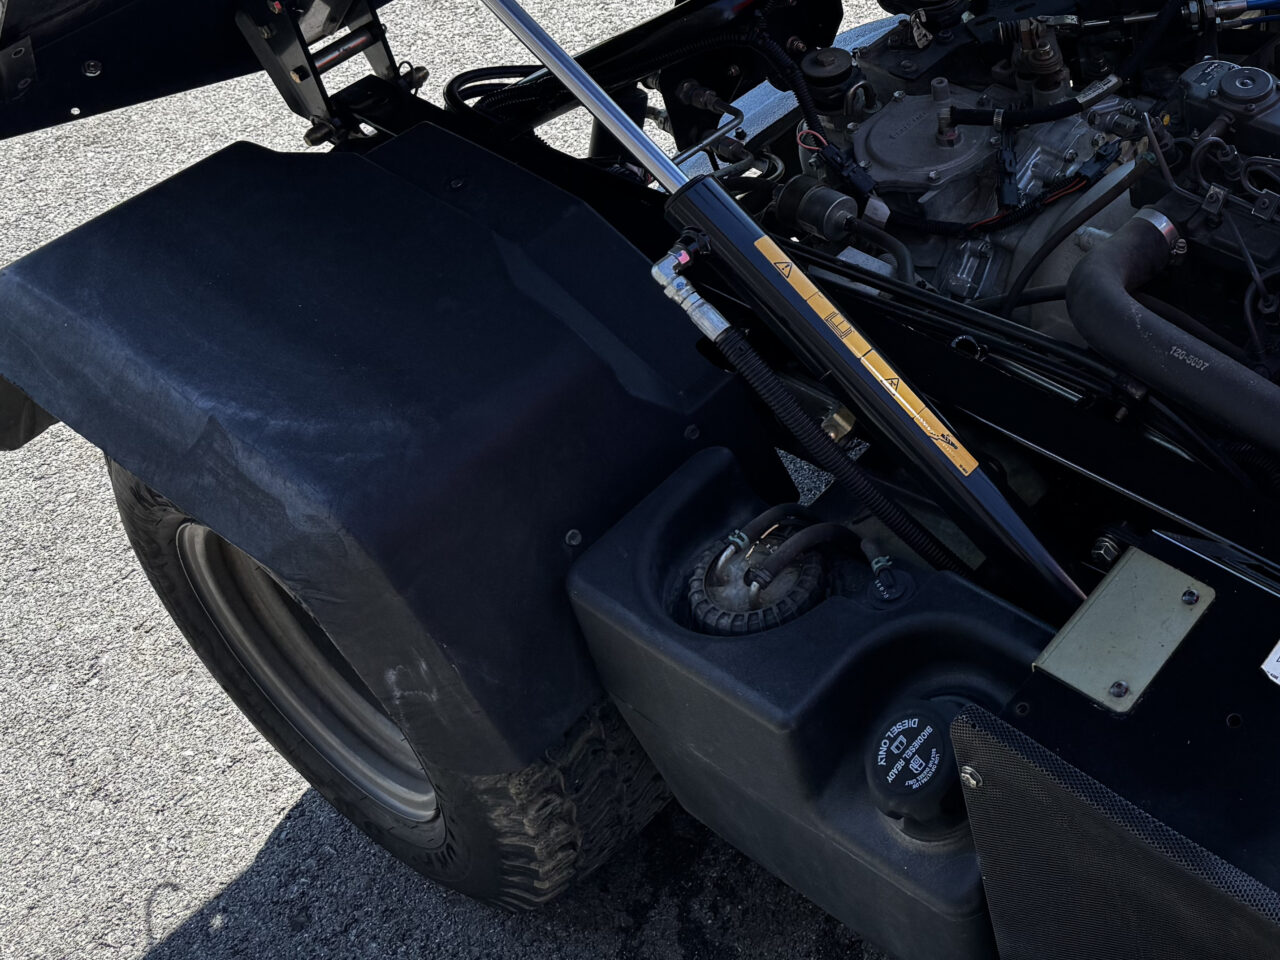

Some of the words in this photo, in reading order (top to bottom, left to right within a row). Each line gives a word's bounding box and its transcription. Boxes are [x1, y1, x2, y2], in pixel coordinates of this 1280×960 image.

[885, 718, 919, 738] DIESEL
[877, 739, 890, 766] ONLY
[902, 725, 933, 759] BIODIESEL
[886, 758, 906, 783] READY
